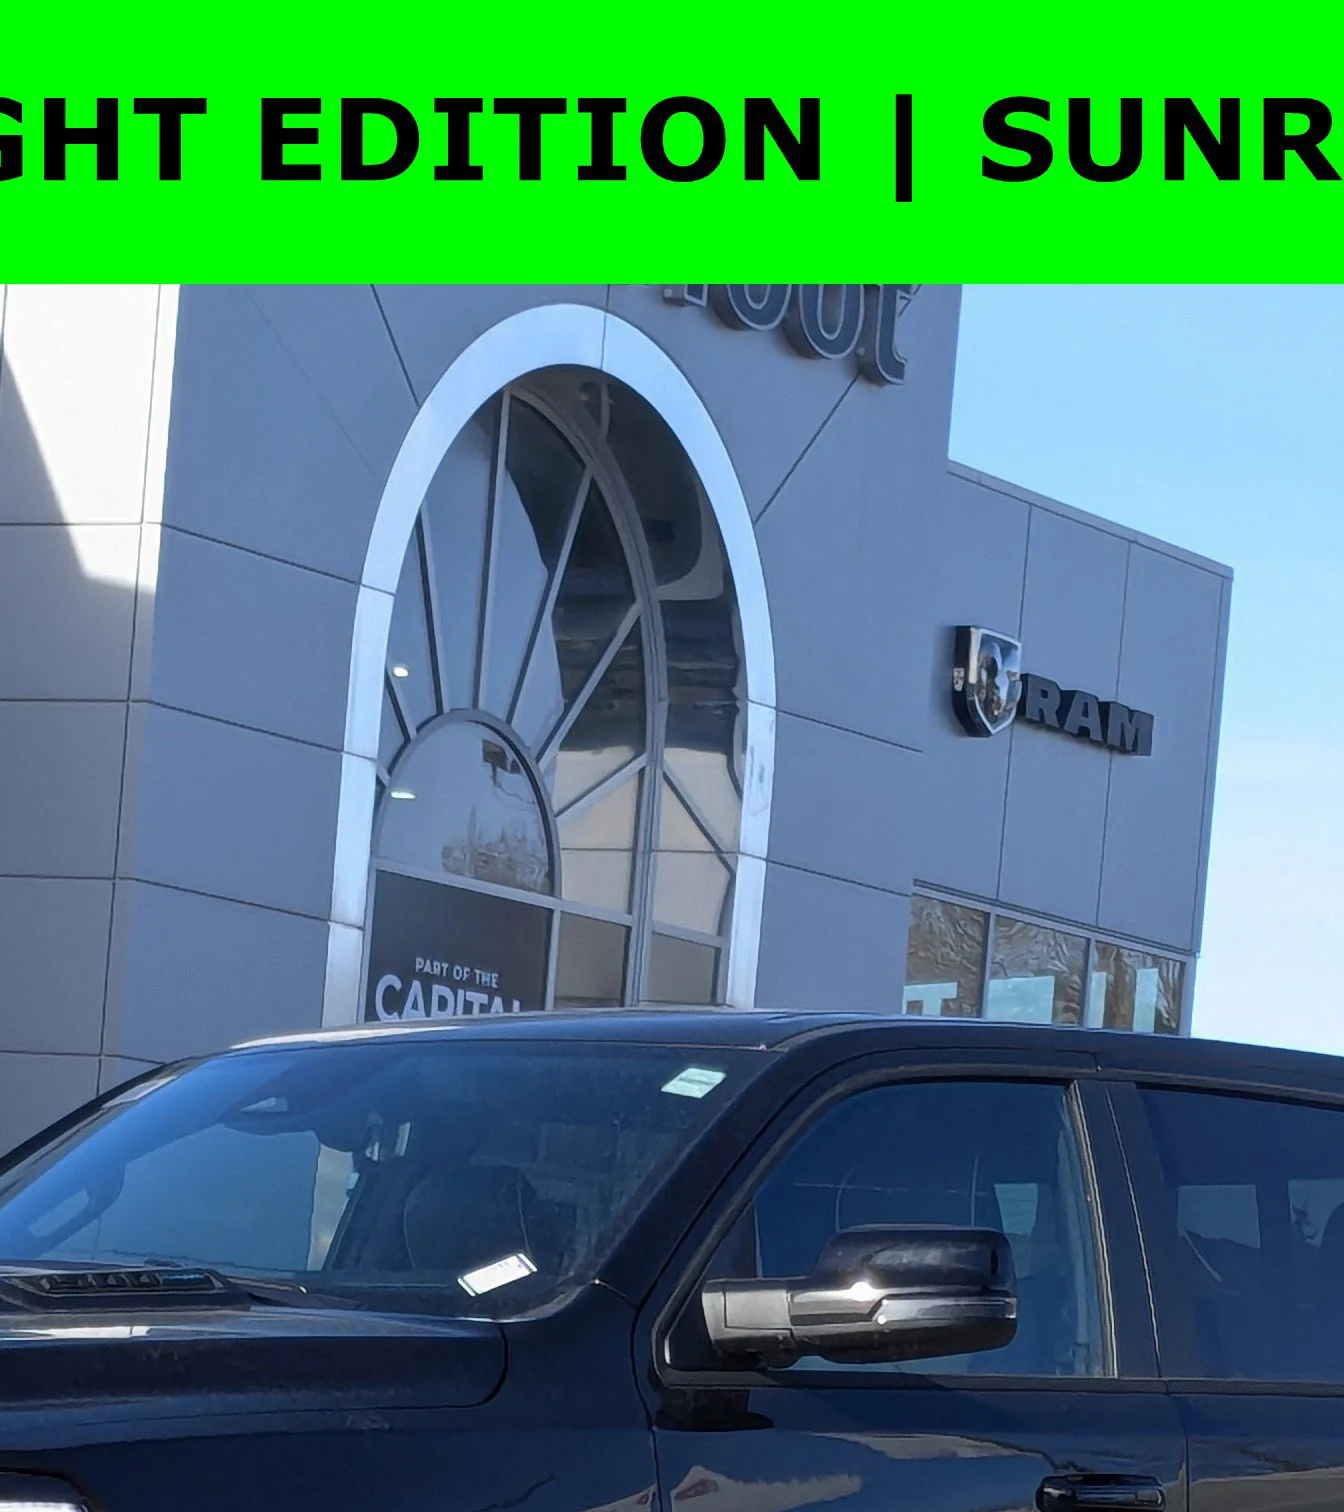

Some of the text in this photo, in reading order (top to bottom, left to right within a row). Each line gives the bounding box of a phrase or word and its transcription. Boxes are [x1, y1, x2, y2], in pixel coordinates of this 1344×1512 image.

[1022, 673, 1155, 757] RAM
[414, 956, 499, 989] PART OF THE
[374, 973, 521, 1022] CAPIT
